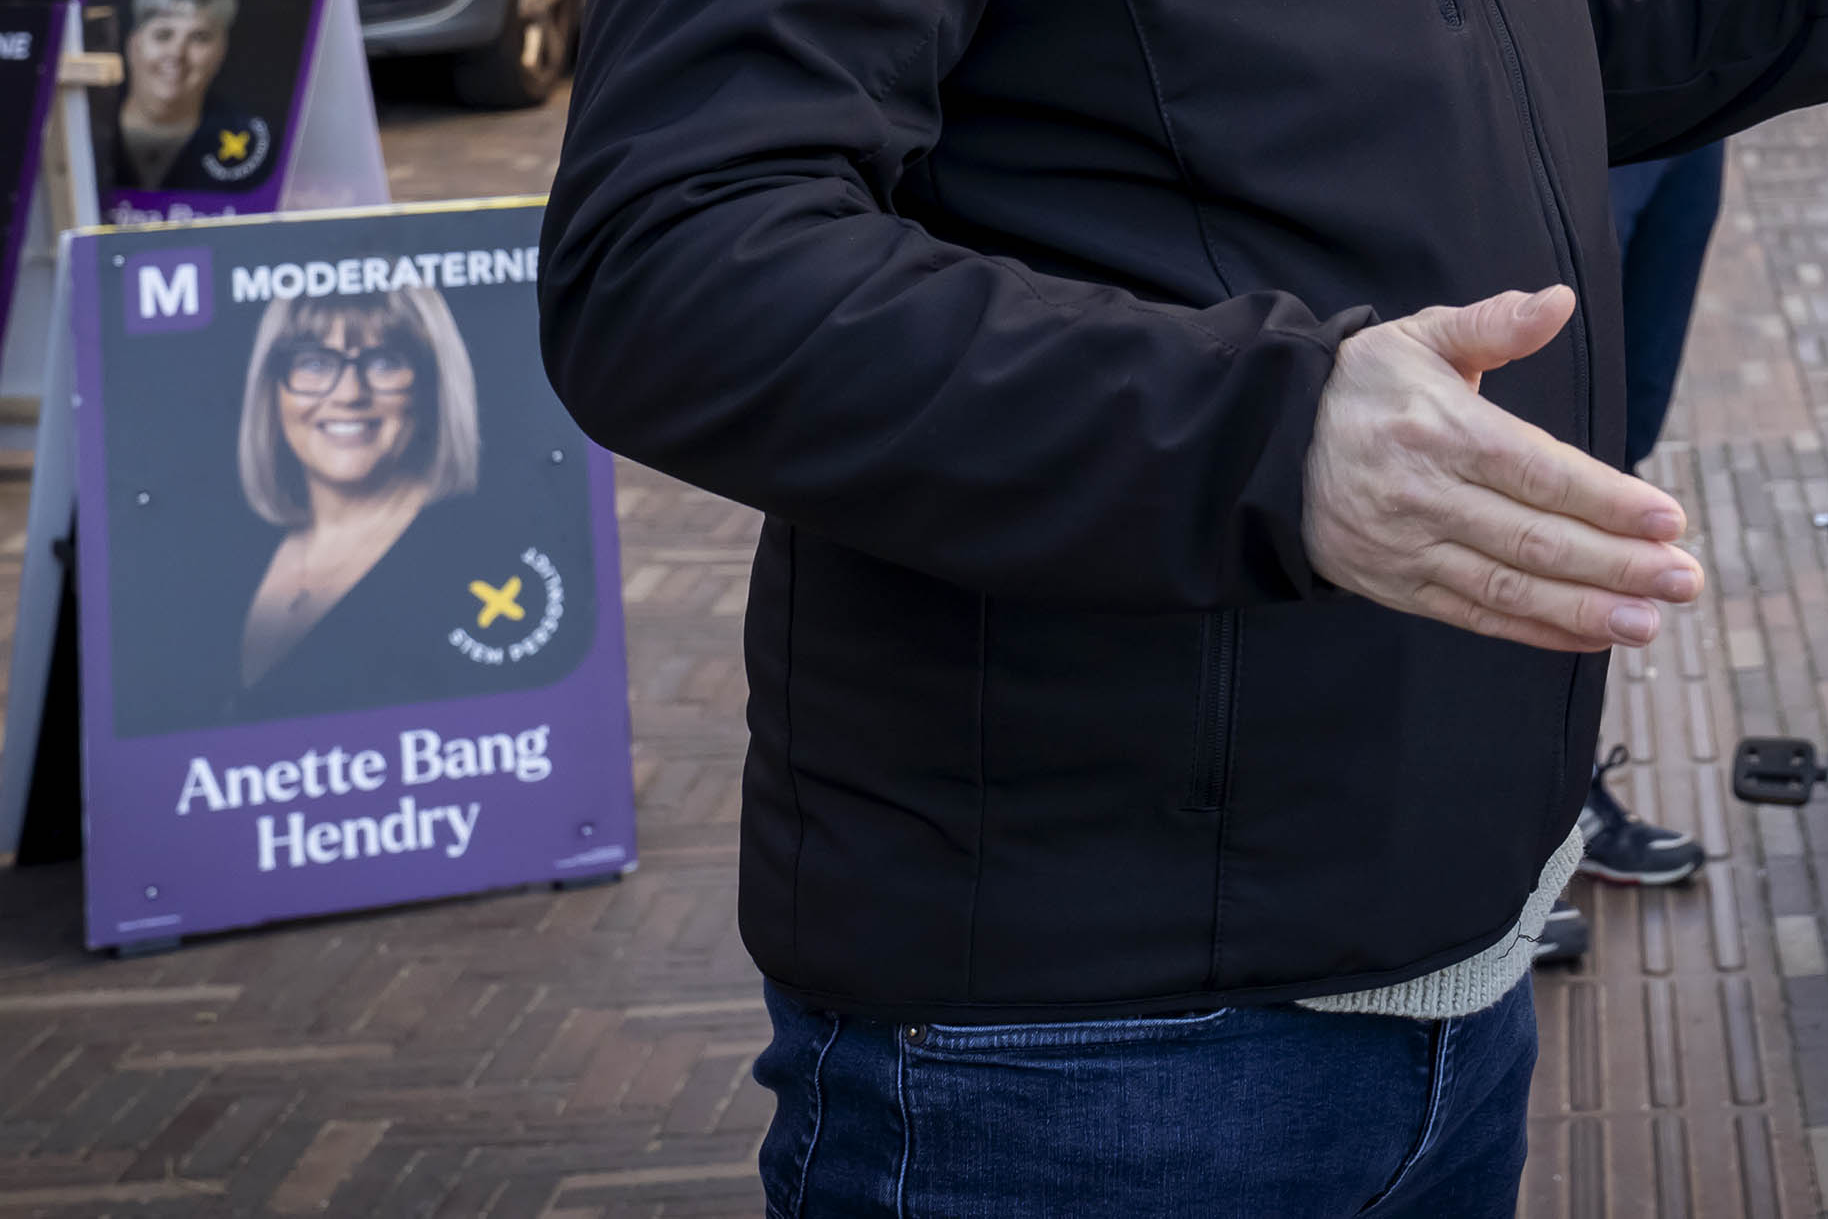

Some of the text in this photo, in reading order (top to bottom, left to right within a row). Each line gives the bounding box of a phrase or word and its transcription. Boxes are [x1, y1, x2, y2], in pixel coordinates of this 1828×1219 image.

[138, 264, 199, 318] M
[448, 628, 505, 665] STEM
[176, 725, 553, 815] Anette Bang
[256, 796, 480, 872] Hendry
